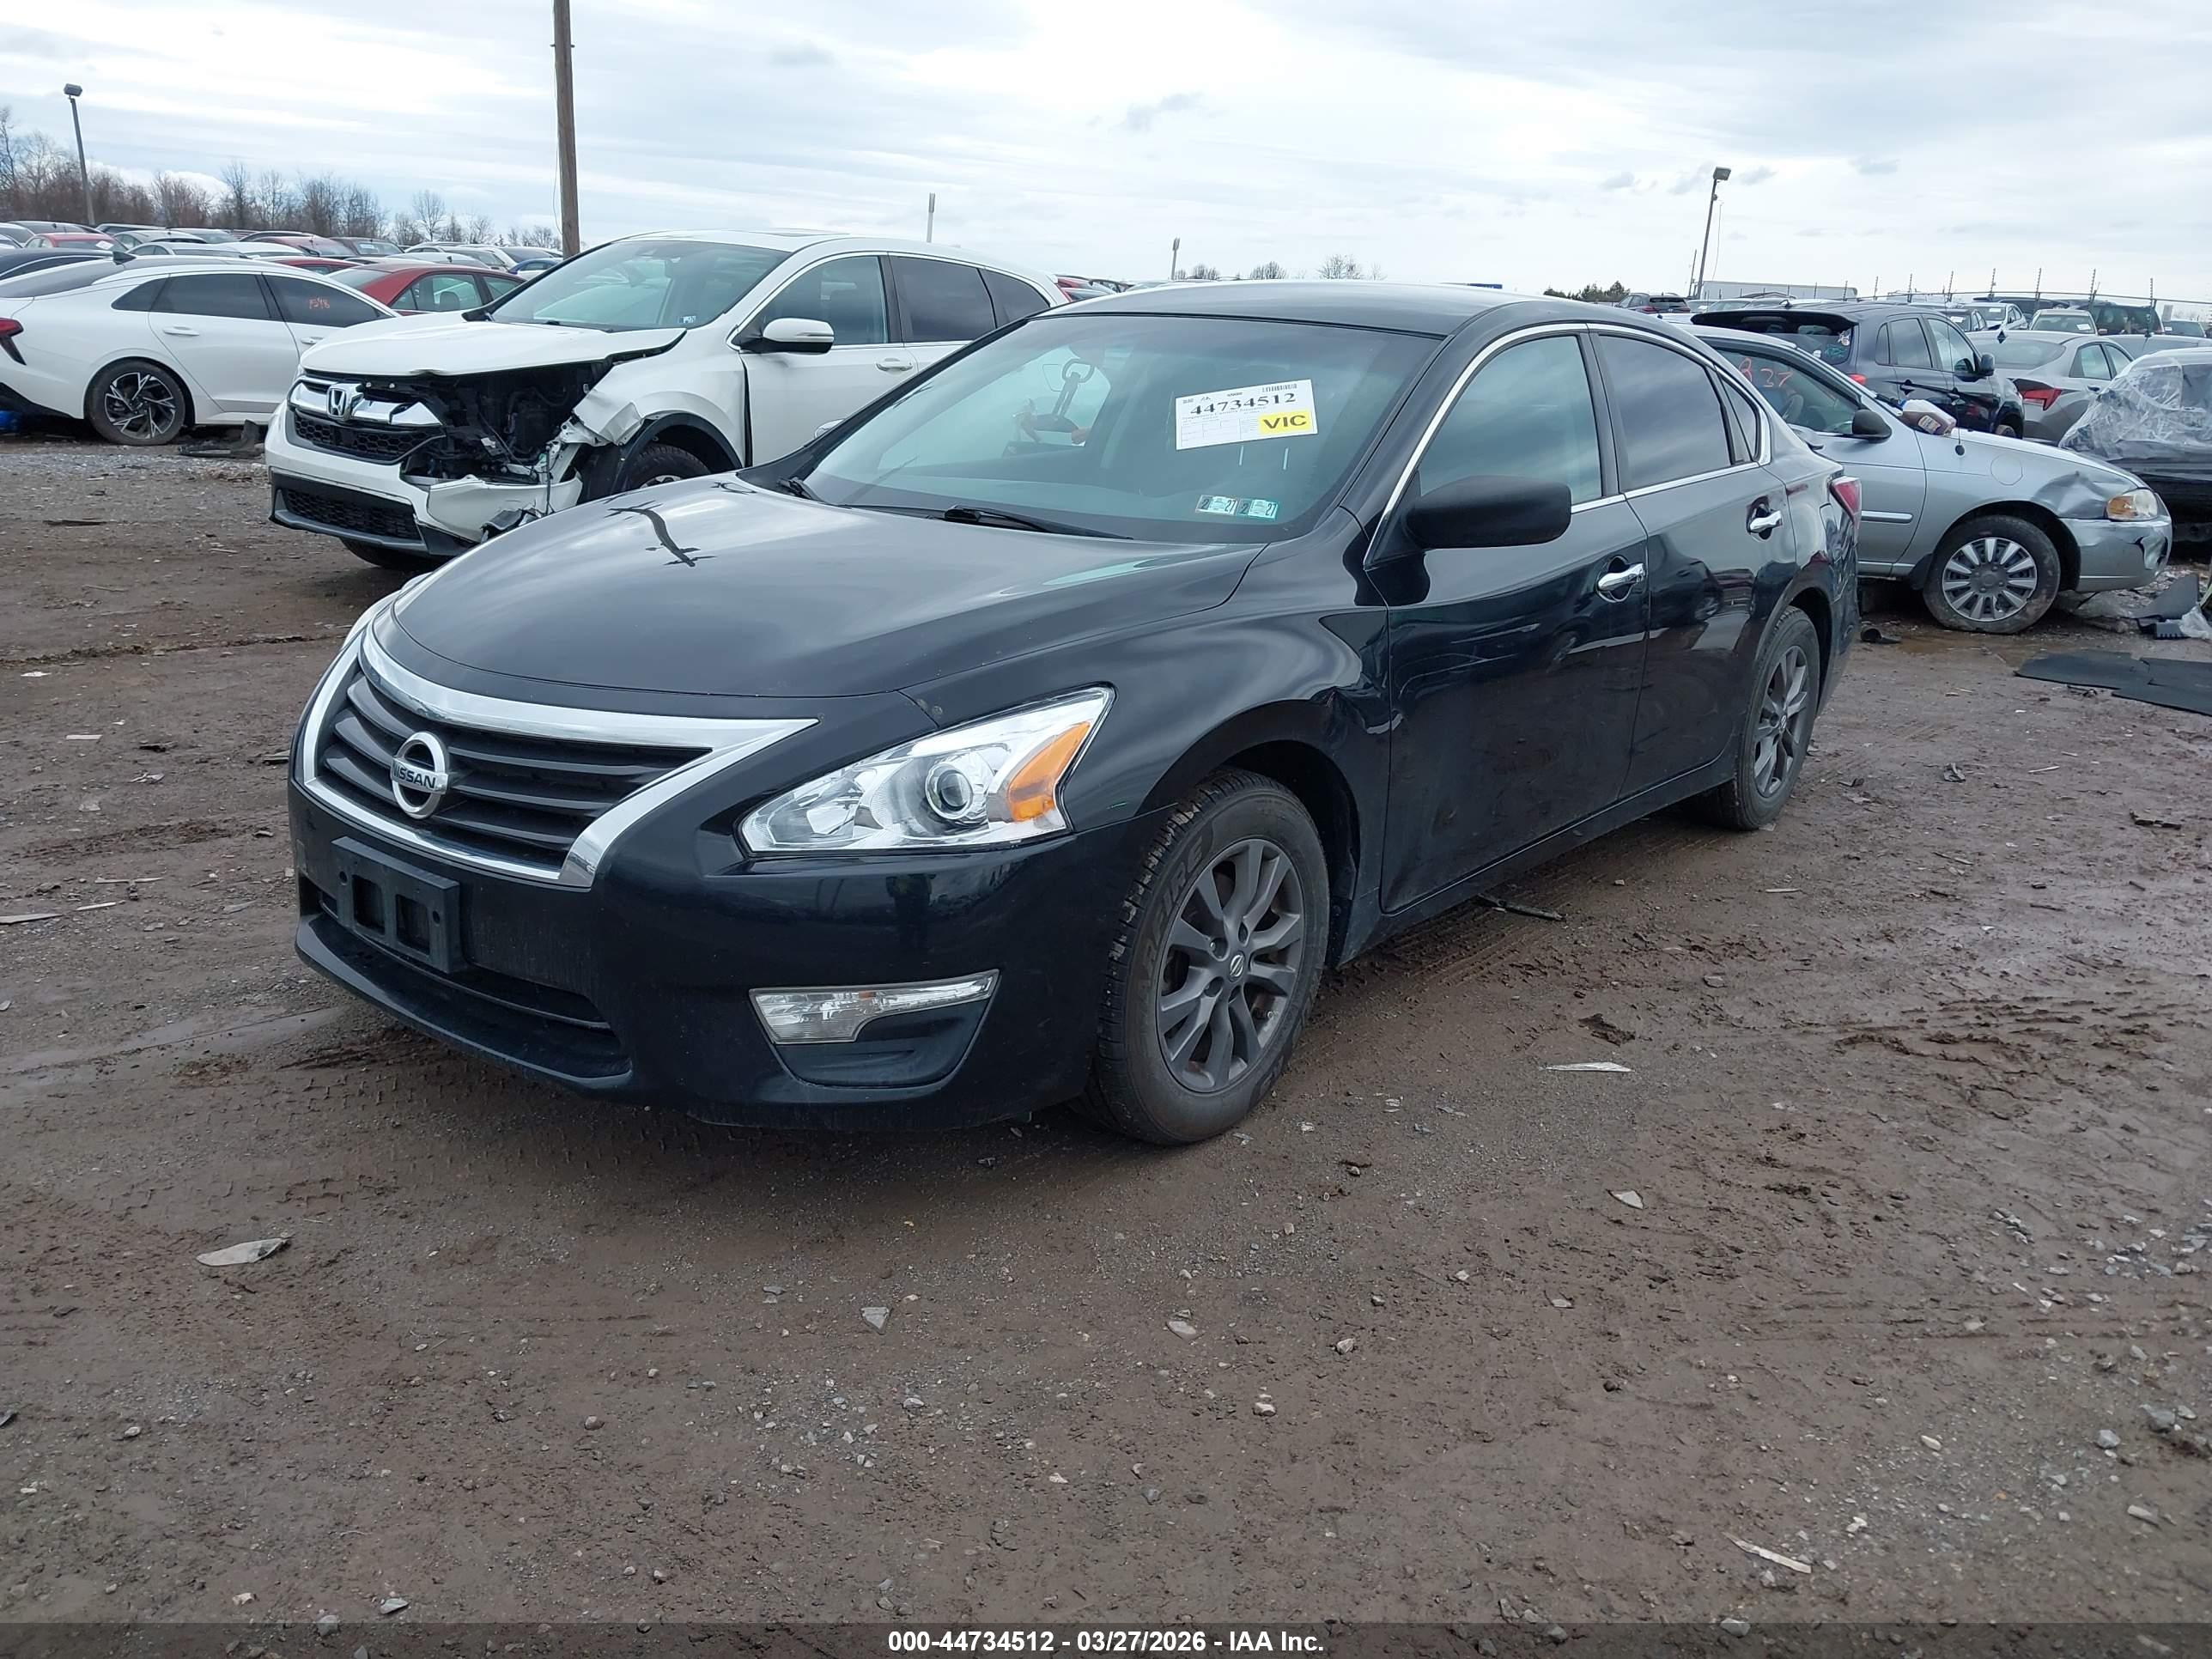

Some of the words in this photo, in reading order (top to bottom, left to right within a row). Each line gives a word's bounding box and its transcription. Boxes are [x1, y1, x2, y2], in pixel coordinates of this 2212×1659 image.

[1190, 392, 1297, 415] 44734512
[1264, 415, 1307, 429] VIC
[1224, 500, 1237, 514] 27
[1265, 503, 1278, 517] 27
[392, 761, 436, 789] NISSAN
